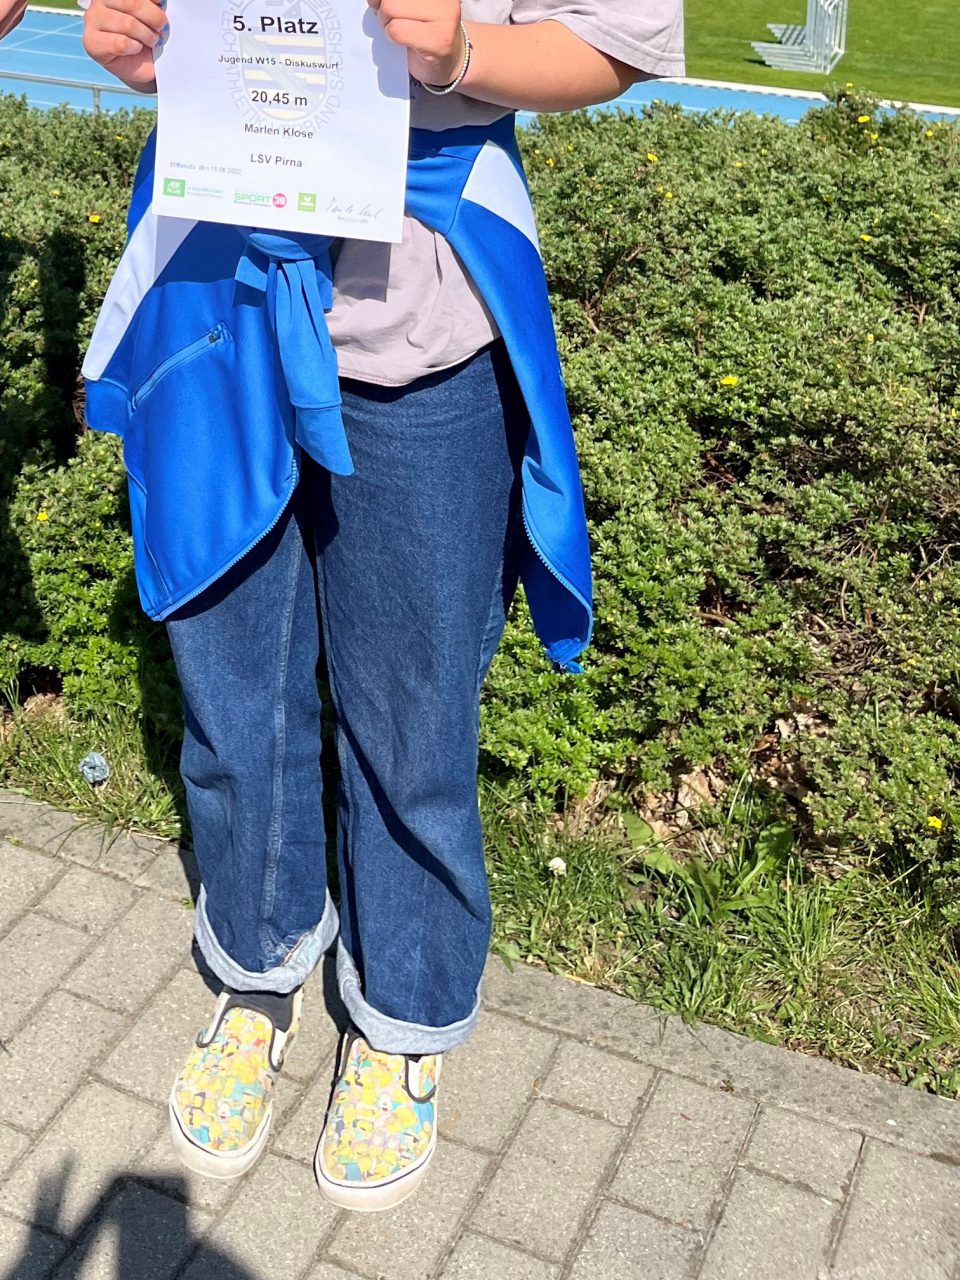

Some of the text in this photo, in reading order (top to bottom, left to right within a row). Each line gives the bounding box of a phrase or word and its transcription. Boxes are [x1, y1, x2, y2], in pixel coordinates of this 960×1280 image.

[233, 15, 319, 35] 5. Platz
[218, 54, 253, 65] Jugend
[255, 56, 276, 65] W15
[284, 58, 339, 70] Diskuswurf
[251, 90, 308, 107] 20,45 m
[244, 123, 314, 139] Marlen Klose
[250, 153, 303, 168] LSV Pirna
[233, 192, 271, 204] SPORT
